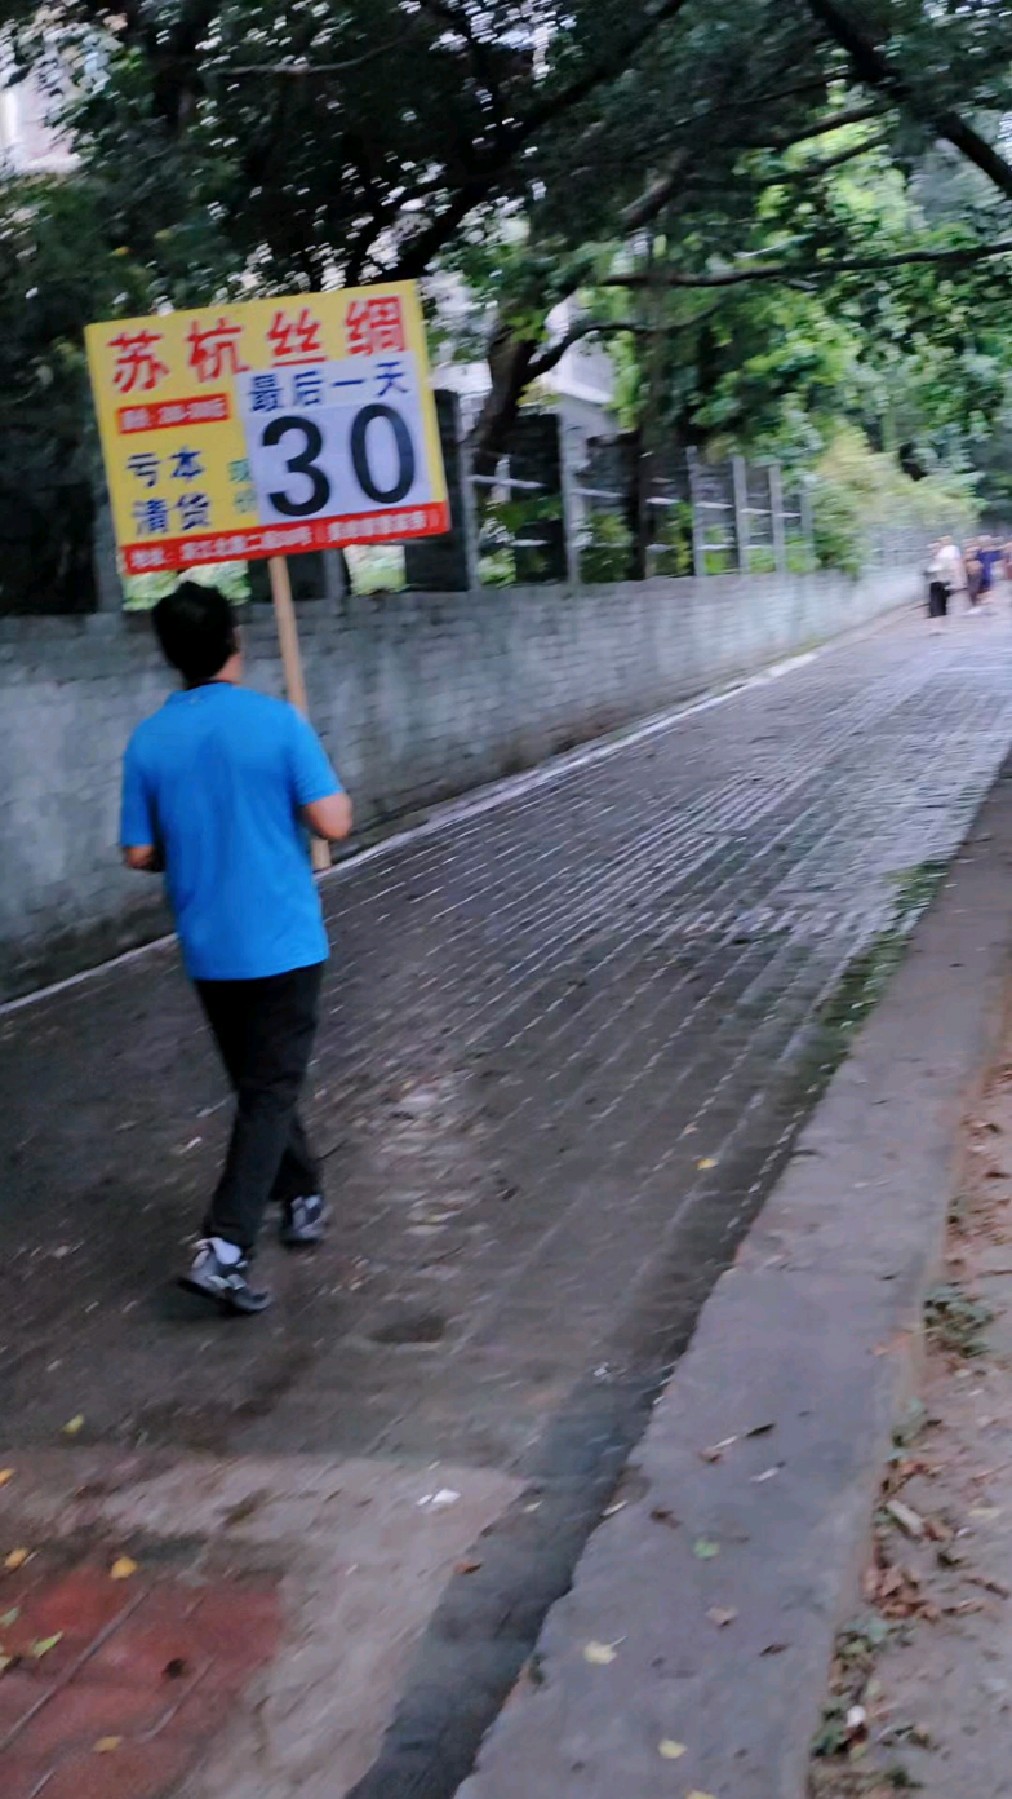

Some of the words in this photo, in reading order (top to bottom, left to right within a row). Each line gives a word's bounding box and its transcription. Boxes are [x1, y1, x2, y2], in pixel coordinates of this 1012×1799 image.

[106, 295, 403, 394] 苏杭丝绸
[248, 361, 409, 413] 最后一天
[127, 446, 204, 488] 亏本
[261, 404, 416, 517] 30
